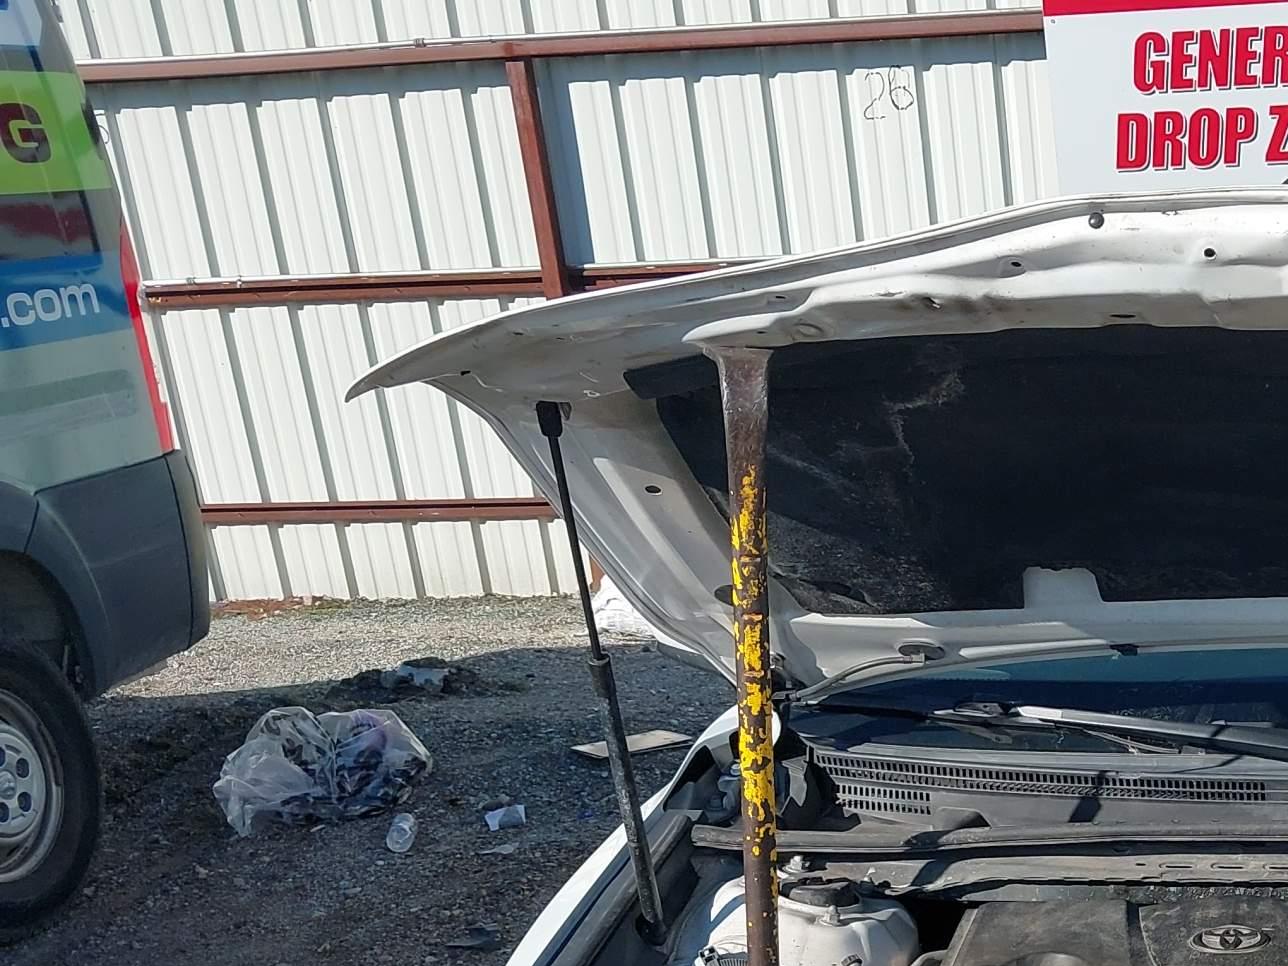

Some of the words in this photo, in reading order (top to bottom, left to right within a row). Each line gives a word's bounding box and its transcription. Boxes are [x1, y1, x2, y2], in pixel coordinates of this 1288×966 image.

[863, 64, 915, 120] 26
[1115, 106, 1259, 173] DROP
[1, 282, 100, 329] .com
